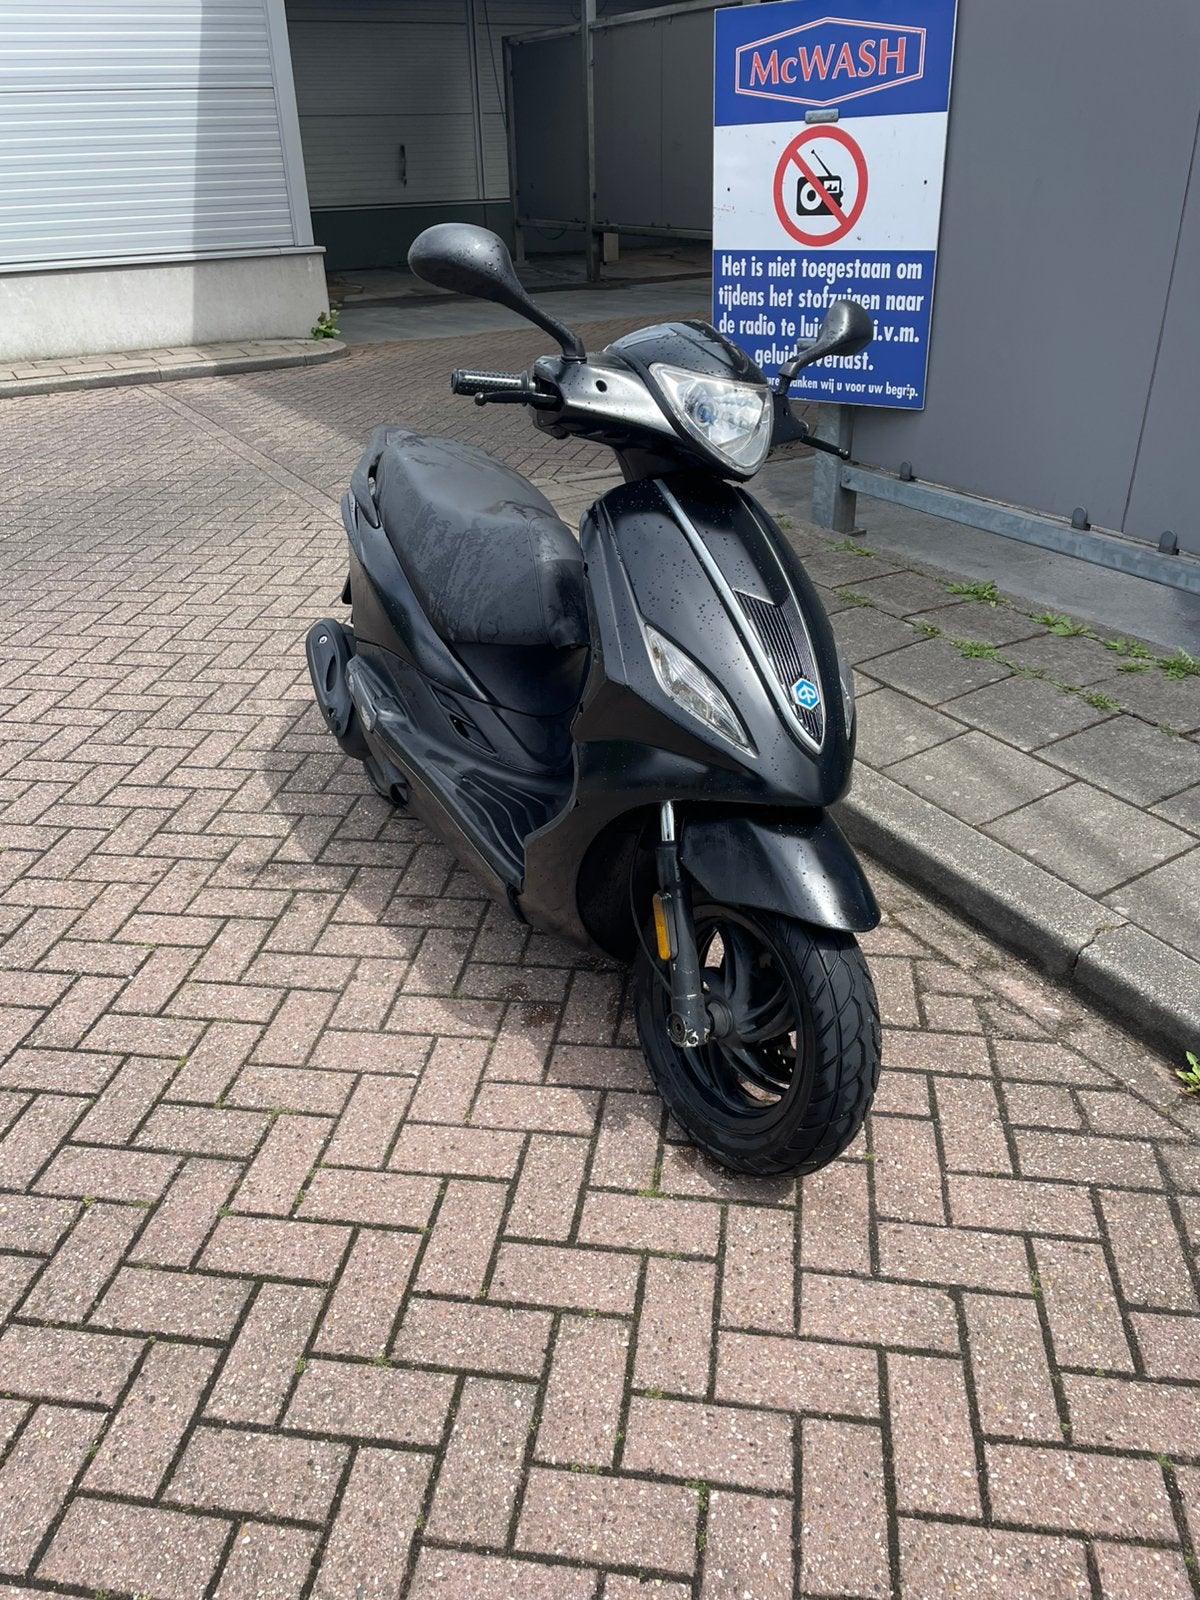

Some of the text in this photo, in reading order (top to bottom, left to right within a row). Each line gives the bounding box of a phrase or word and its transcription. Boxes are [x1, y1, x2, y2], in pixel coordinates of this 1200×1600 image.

[749, 37, 907, 87] McWASH
[721, 254, 923, 285] Het is niet toegestaan om
[718, 283, 765, 312] tijdens
[769, 284, 793, 307] het
[885, 294, 924, 312] naar
[719, 312, 735, 334] de
[739, 313, 776, 336] radio
[780, 318, 796, 337] te
[872, 319, 920, 343] i.v.m.
[820, 378, 835, 394] wij
[836, 382, 843, 391] u
[845, 382, 866, 393] voor
[868, 384, 884, 394] uw
[885, 381, 919, 400] begrip.
